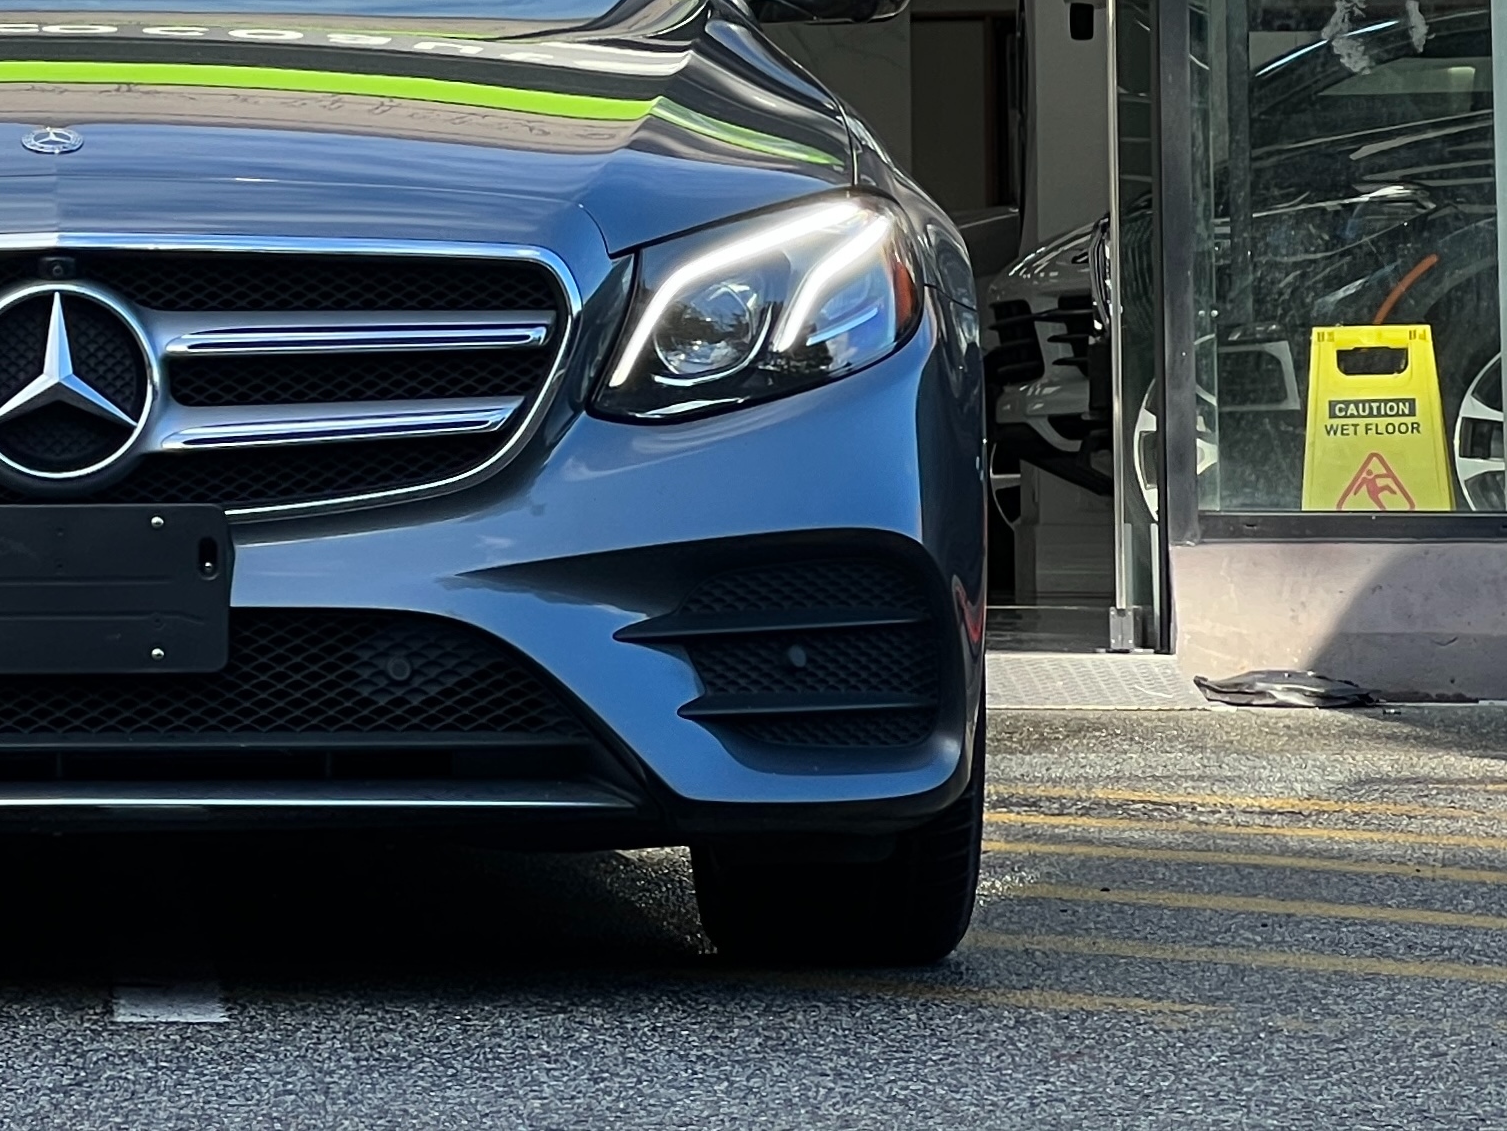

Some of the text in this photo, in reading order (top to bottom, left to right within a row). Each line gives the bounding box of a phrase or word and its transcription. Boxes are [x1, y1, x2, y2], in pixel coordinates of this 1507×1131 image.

[1335, 402, 1410, 416] CAUTION
[1325, 422, 1421, 436] WET FLOOR
